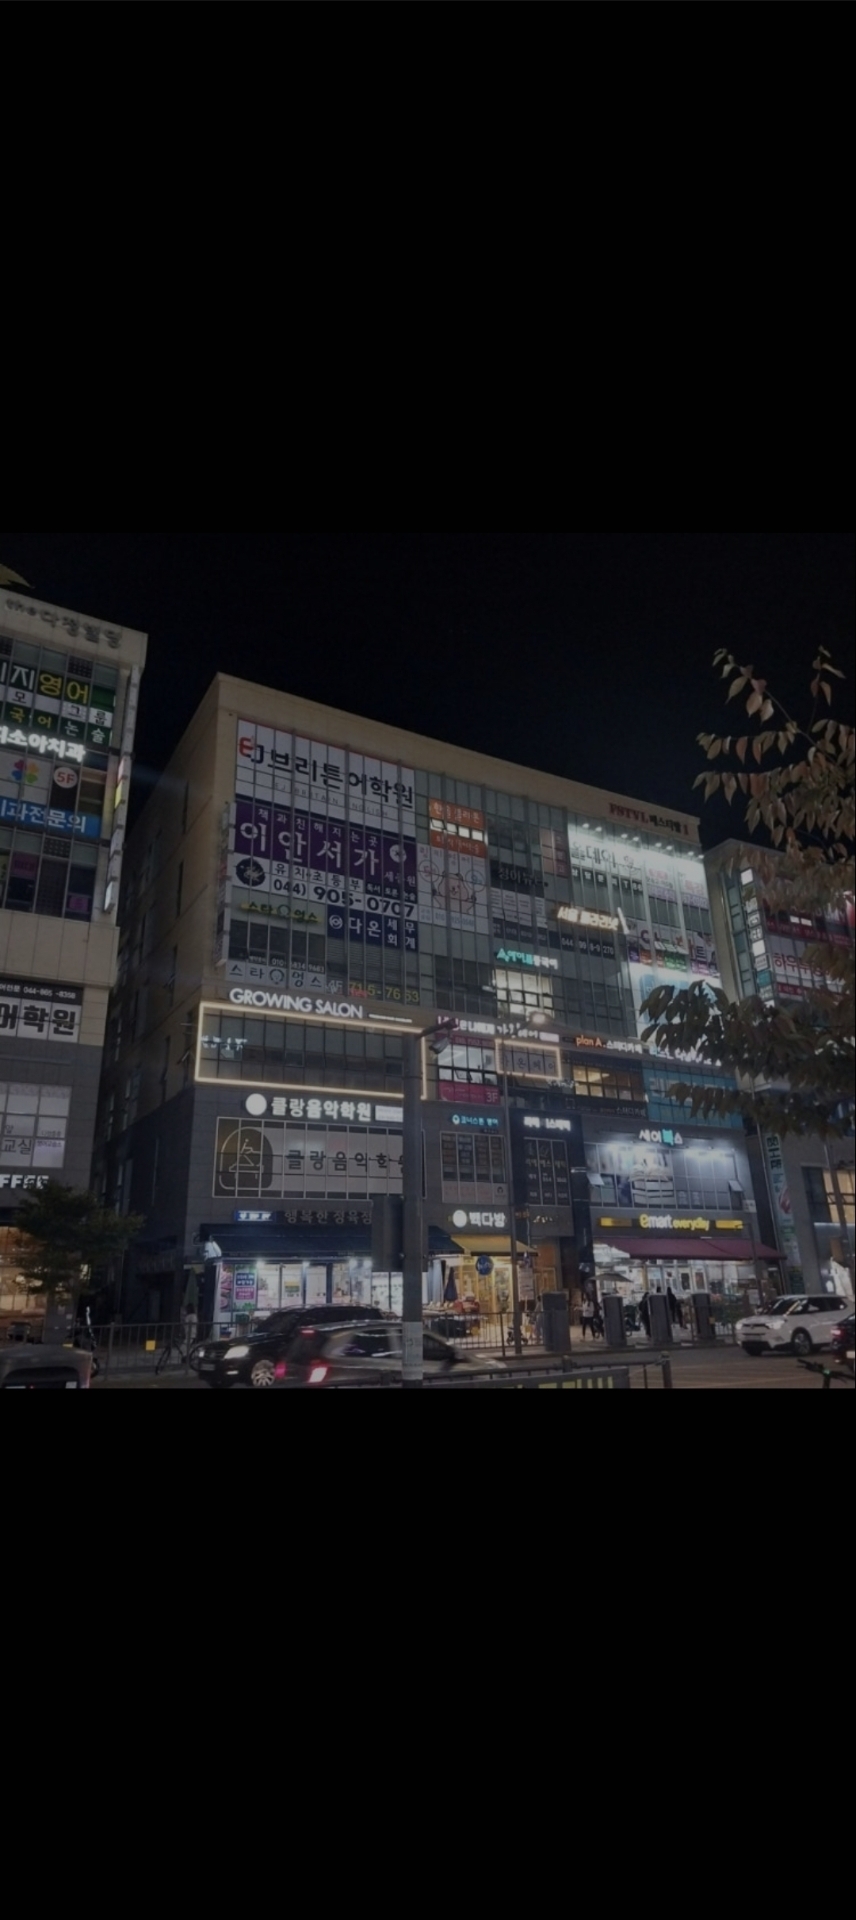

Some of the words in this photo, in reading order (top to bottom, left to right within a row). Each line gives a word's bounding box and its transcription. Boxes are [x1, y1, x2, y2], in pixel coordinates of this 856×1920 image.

[56, 771, 75, 784] 5F
[240, 822, 380, 876] 이안서가
[0, 1003, 76, 1036] 어학원
[229, 988, 313, 1013] GROWING
[315, 998, 364, 1019] SALON
